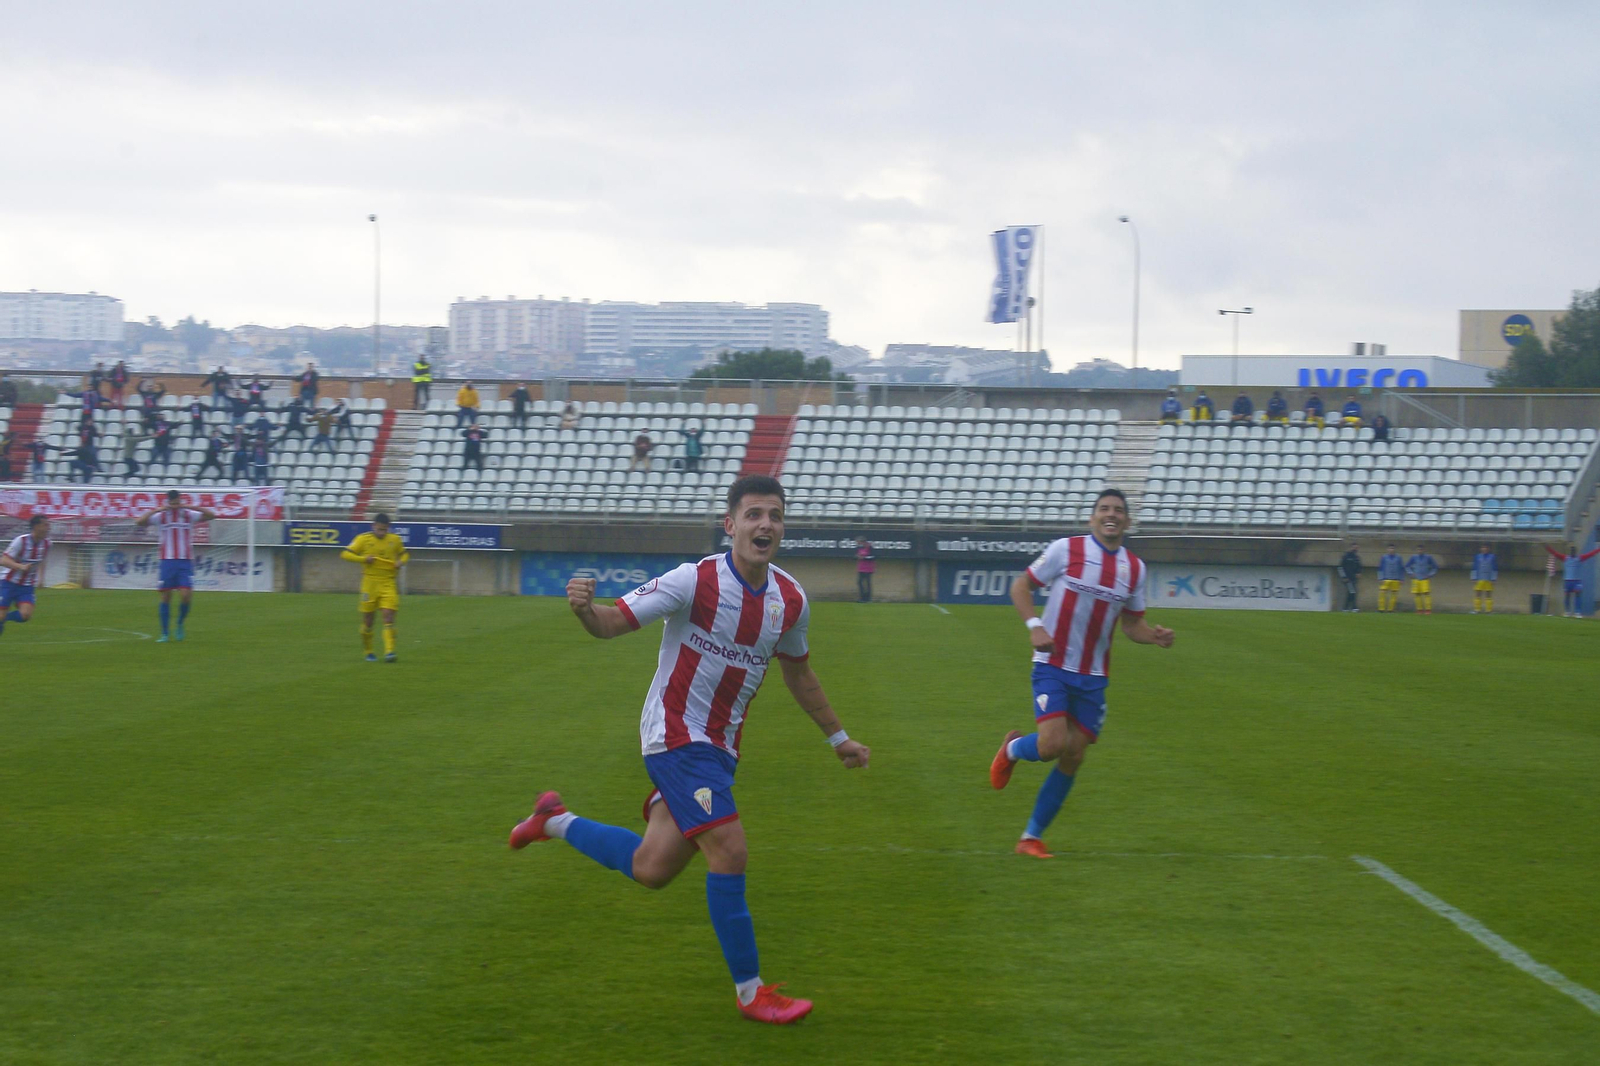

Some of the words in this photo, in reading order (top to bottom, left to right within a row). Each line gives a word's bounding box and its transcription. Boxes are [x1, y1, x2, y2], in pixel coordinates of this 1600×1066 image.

[1298, 367, 1428, 388] IVECO
[936, 536, 1056, 555] universoapo
[1200, 575, 1311, 600] CaixaBank
